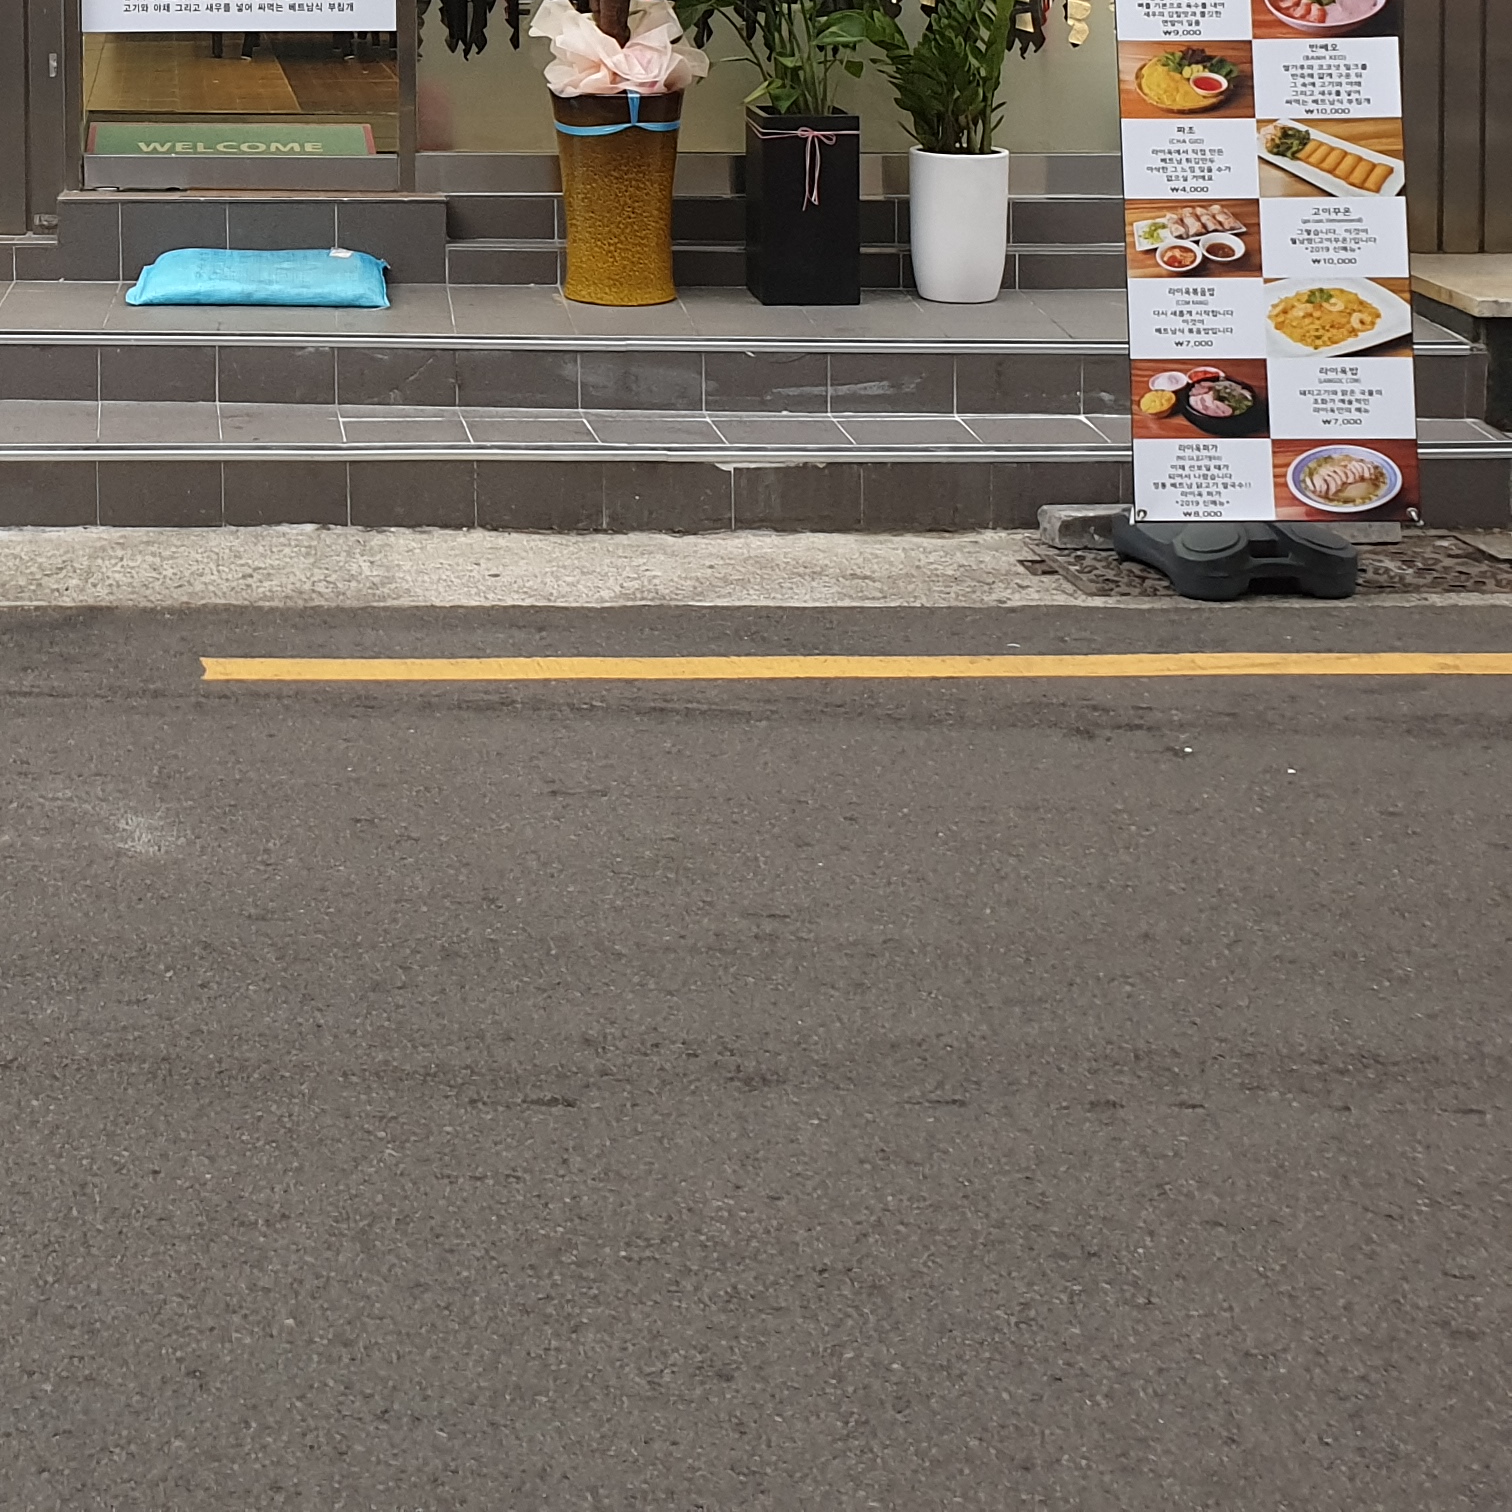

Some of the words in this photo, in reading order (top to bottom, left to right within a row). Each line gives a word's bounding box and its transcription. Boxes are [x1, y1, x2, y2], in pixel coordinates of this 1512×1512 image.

[122, 2, 149, 13] 고기와
[174, 2, 201, 13] 그리고
[288, 2, 323, 13] 베트남식
[1162, 29, 1202, 38] ₩9,000
[1304, 107, 1351, 116] ₩10,000
[137, 141, 324, 153] WELCOME
[1169, 186, 1209, 194] ₩4,000
[1311, 257, 1358, 266] ₩10,000
[1174, 340, 1214, 348] ₩7,000
[1321, 418, 1363, 427] ₩7,000
